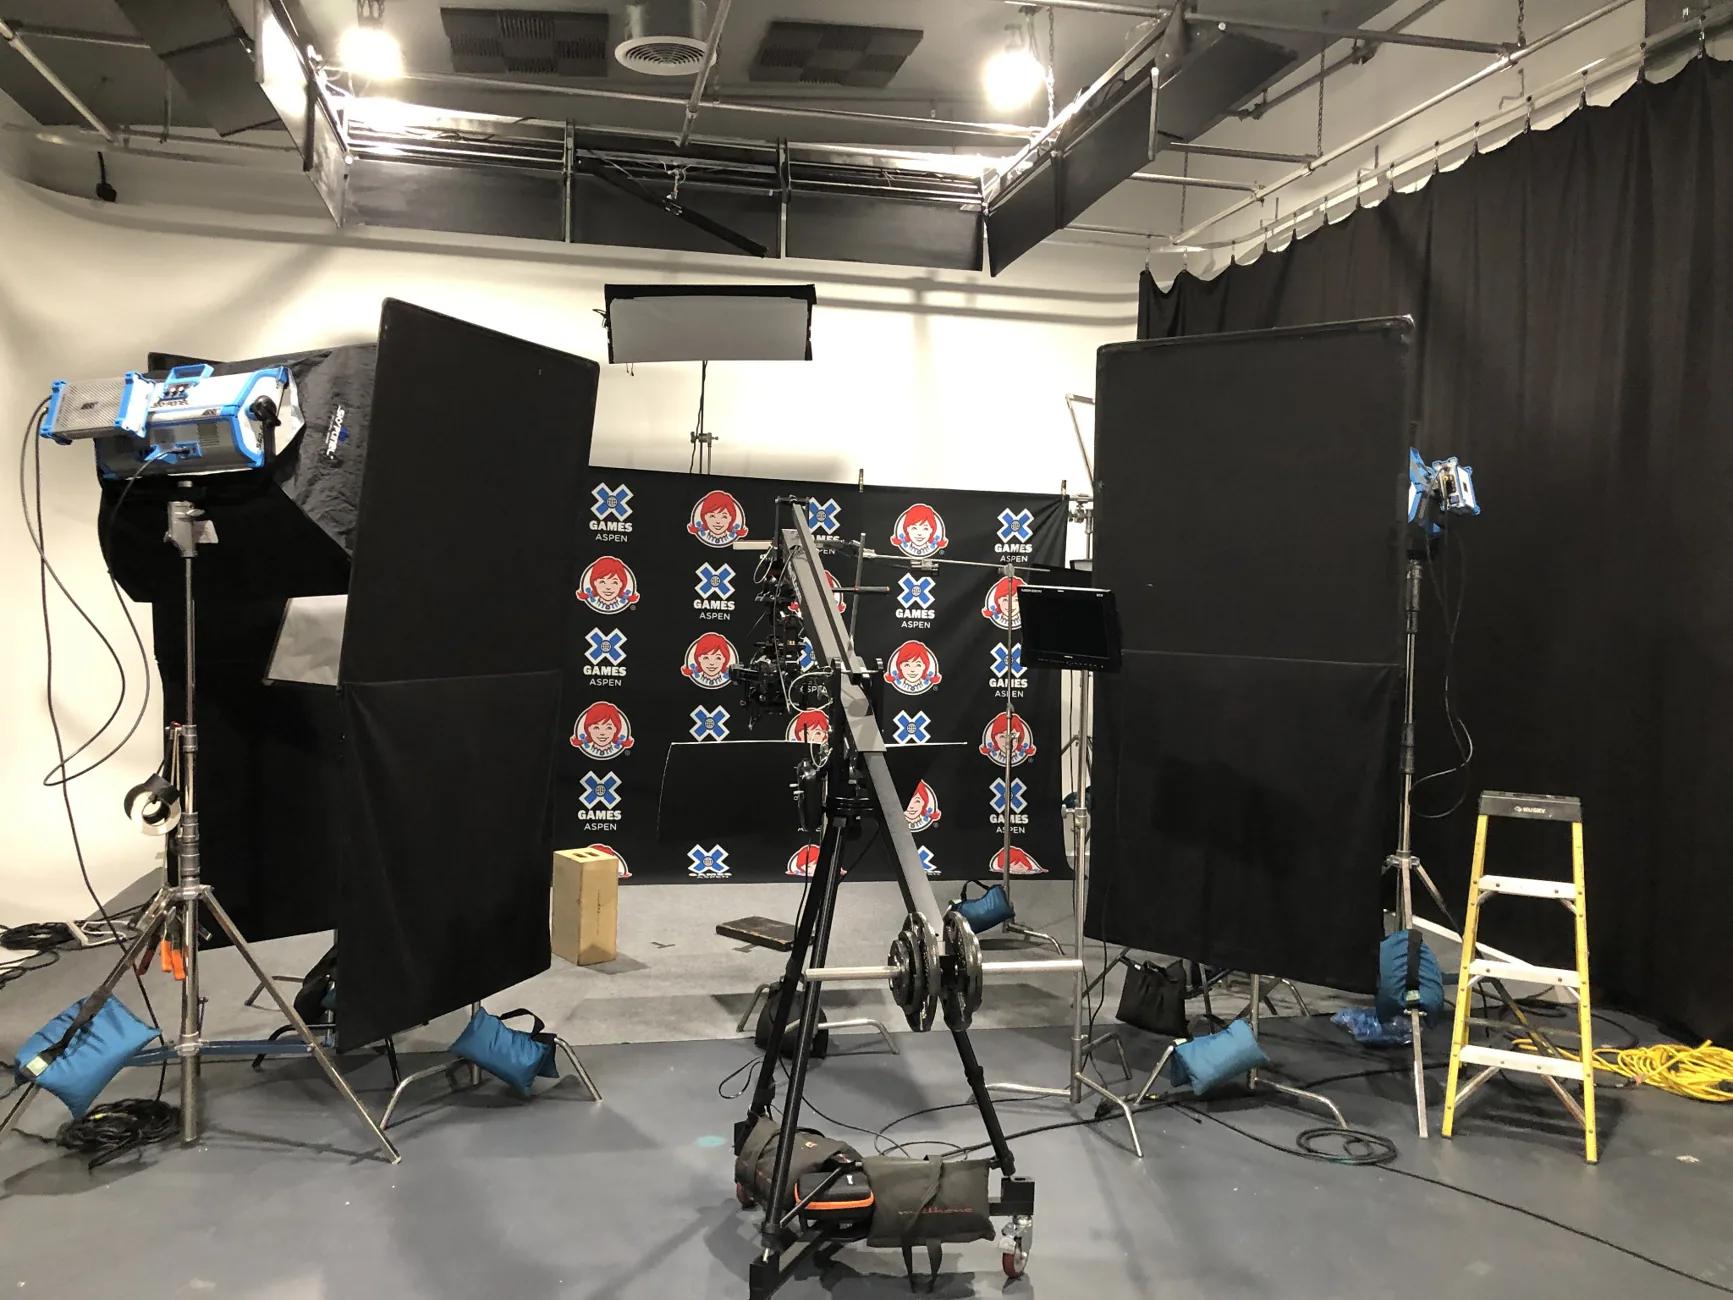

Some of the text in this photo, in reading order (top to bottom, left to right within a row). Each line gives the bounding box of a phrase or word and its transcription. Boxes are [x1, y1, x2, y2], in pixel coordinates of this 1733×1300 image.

[589, 520, 633, 532] GAMES
[595, 533, 628, 543] ASPEN
[994, 543, 1033, 554] GAMES
[1000, 555, 1029, 563] ASPEN
[693, 599, 735, 611] GAMES
[699, 612, 731, 621] ASPEN
[895, 608, 936, 620] GAMES
[901, 620, 931, 629] ASPEN
[583, 665, 627, 677] GAMES
[589, 678, 622, 687] ASPEN
[577, 809, 622, 821] GAMES
[583, 822, 617, 831] ASPEN
